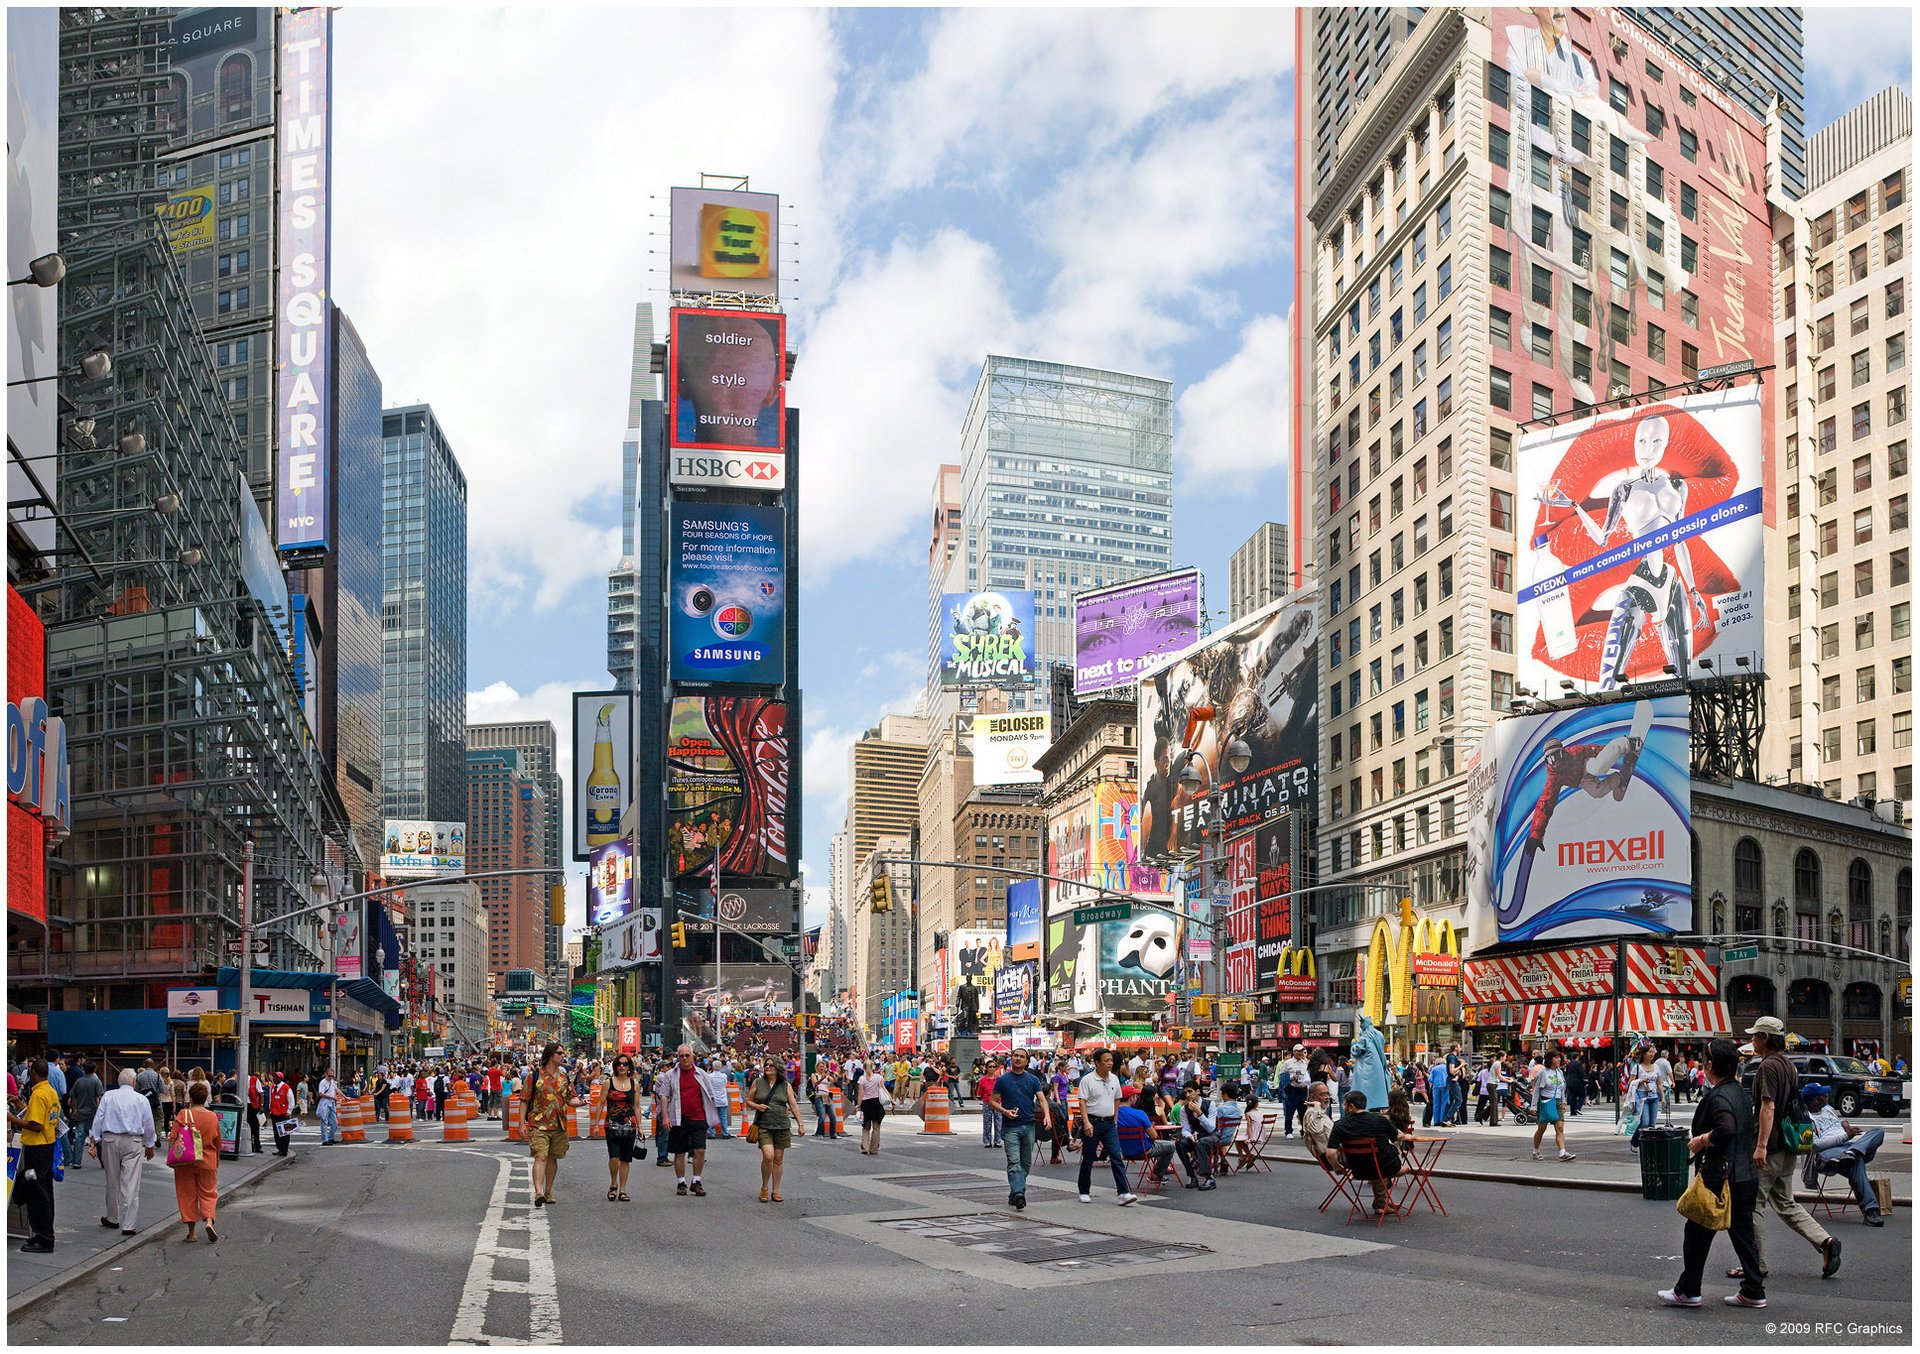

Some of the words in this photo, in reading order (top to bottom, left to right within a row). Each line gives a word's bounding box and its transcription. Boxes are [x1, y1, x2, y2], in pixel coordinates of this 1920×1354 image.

[182, 17, 242, 43] SQUARE
[1611, 10, 1686, 77] Colombian
[1689, 70, 1732, 113] Coffee
[287, 40, 322, 230] TIMES
[180, 237, 211, 249] Station
[1710, 272, 1754, 360] Juan
[705, 332, 753, 347] soldier
[286, 252, 322, 490] SQUARE
[711, 373, 746, 387] style
[700, 413, 758, 428] survivor
[675, 457, 742, 479] HSBC
[289, 516, 315, 528] NYC
[682, 519, 749, 532] SAMSUNG'S
[682, 531, 703, 539] FOUR
[705, 532, 739, 540] SEASONS
[753, 534, 773, 542] HOPE
[1572, 564, 1594, 579] man
[1597, 547, 1631, 568] cannot
[1633, 536, 1653, 554] live
[1655, 530, 1669, 544] on
[1671, 517, 1708, 540] gossip
[1711, 500, 1749, 522] alone.
[682, 542, 697, 551] For
[700, 544, 724, 552] more
[726, 543, 776, 555] information
[682, 552, 712, 562] please
[715, 553, 733, 562] visit
[682, 563, 779, 573] www.fourseasonsofhope.com
[1533, 574, 1568, 596] SVEDKA
[1541, 592, 1565, 604] VODKA
[1717, 592, 1740, 606] voted
[1742, 591, 1753, 601] #1
[1724, 602, 1750, 615] vodka
[1721, 617, 1730, 628] of
[1731, 613, 1754, 627] 2033.
[694, 649, 761, 661] SAMSUNG
[949, 632, 1026, 663] SHREK
[955, 659, 1028, 679] MUSICAL
[1079, 660, 1113, 680] next
[1116, 657, 1134, 673] to
[990, 719, 998, 733] THE
[998, 717, 1044, 733] CLOSER
[681, 737, 711, 748] Open
[990, 734, 1028, 742] MONDAYS
[668, 747, 725, 757] Happiness
[1241, 774, 1255, 783] SAM
[1256, 758, 1302, 778] WORTHINGTON
[589, 784, 618, 796] Corona
[706, 785, 732, 793] Janelle
[1184, 783, 1308, 832] SAVATION
[1239, 813, 1262, 826] BACK
[1265, 804, 1290, 818] 05.21
[1712, 807, 1741, 822] FOLKS
[1743, 813, 1767, 827] SHOE
[1769, 817, 1792, 832] SHOP
[1794, 824, 1836, 841] DEDICATED
[1558, 829, 1664, 867] maxell
[1260, 863, 1289, 884] BROAD
[1586, 862, 1664, 874] www.maxell.com
[1260, 876, 1290, 899] WAY'S
[1260, 898, 1290, 917] SURE
[1080, 909, 1122, 922] Broadway
[743, 922, 780, 930] LACROSSE
[1260, 912, 1290, 939] THING
[1738, 950, 1748, 958] Av
[1415, 959, 1459, 967] McDonald's
[1477, 978, 1500, 988] FRIDAY'S
[1522, 973, 1548, 984] FRIDAY'S
[268, 1003, 304, 1012] TISHMAN
[1466, 1011, 1476, 1022] 47
[1554, 1015, 1574, 1023] FRIDAY'S
[622, 1020, 636, 1045] tkts
[900, 1021, 914, 1045] tkts
